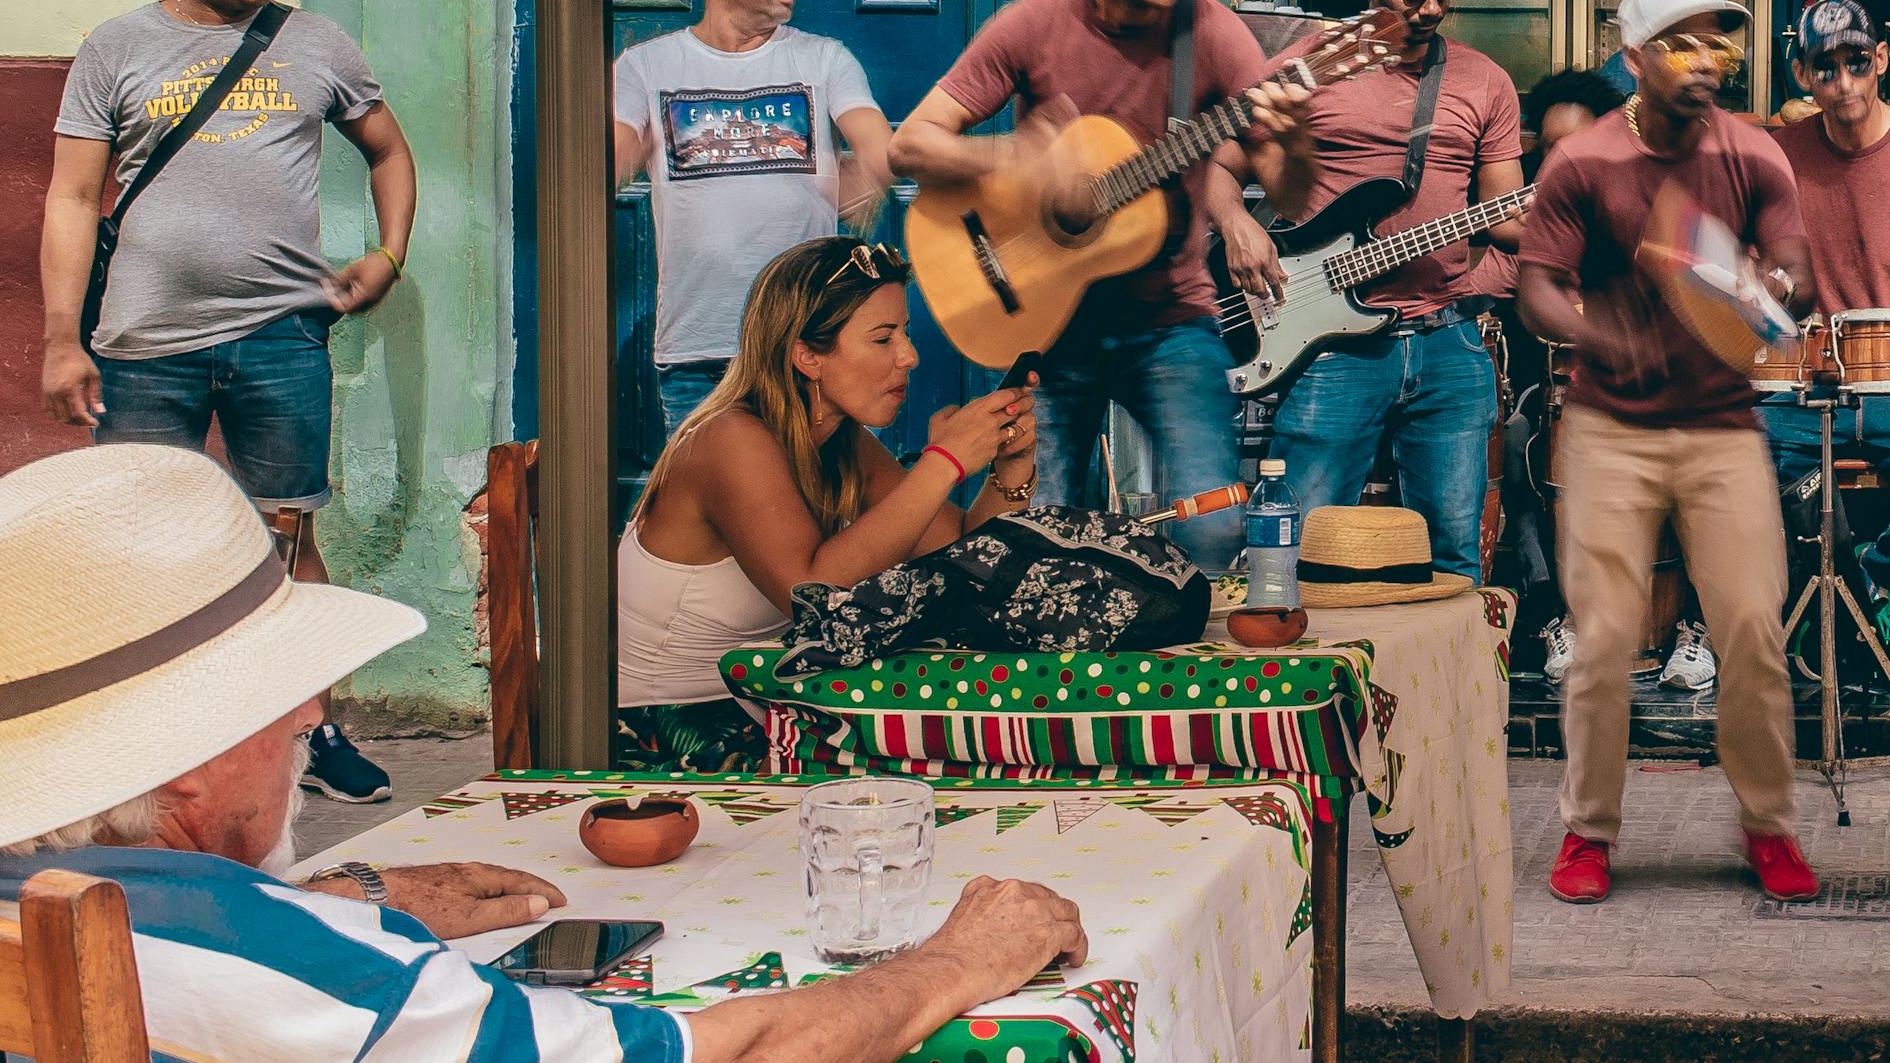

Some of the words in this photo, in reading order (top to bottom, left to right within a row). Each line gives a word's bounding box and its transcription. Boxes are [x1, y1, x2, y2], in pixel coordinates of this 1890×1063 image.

[161, 77, 279, 96] PITTSRGH
[145, 92, 298, 119] VOLLYBALL
[689, 102, 792, 123] EXPLORE
[228, 112, 270, 141] TEXAS
[712, 123, 771, 140] MORE
